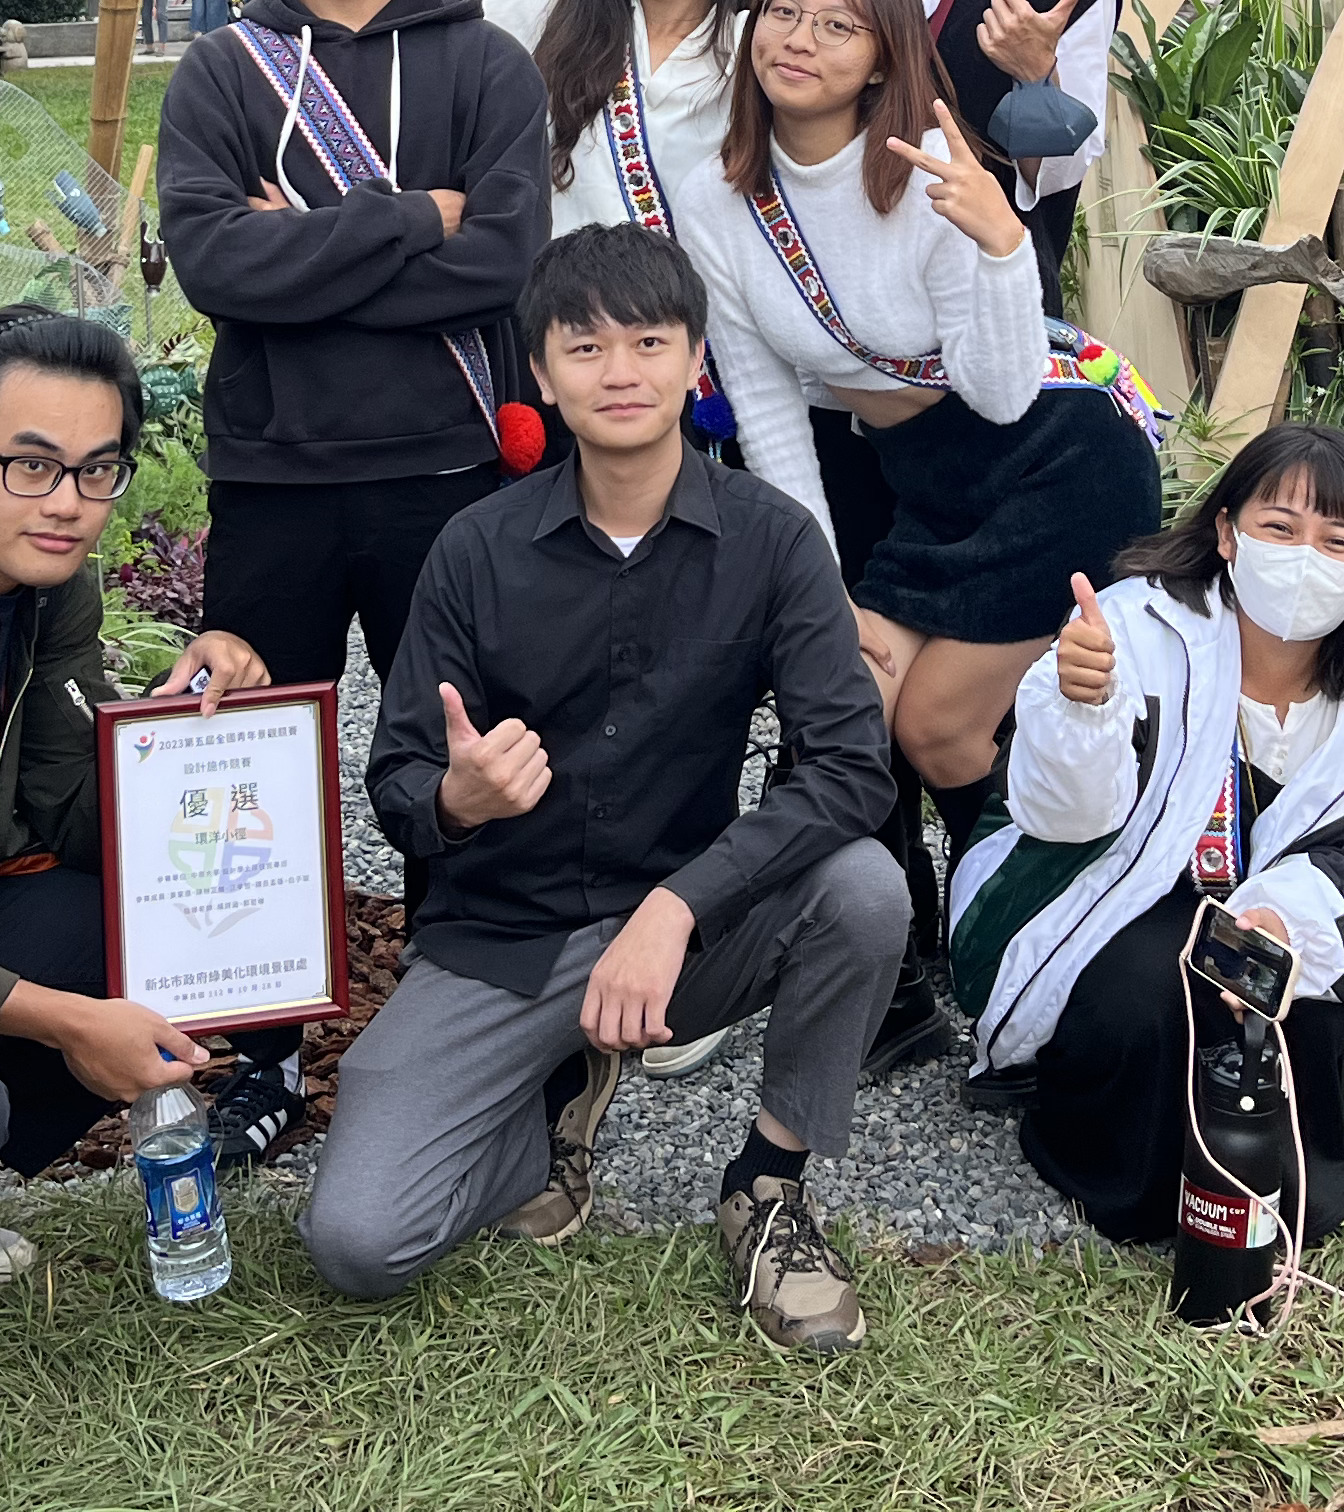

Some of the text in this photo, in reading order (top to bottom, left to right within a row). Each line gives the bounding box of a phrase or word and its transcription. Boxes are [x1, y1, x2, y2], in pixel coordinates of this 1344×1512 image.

[195, 827, 247, 845] 環洋小徑
[1184, 1189, 1228, 1222] VACUUM
